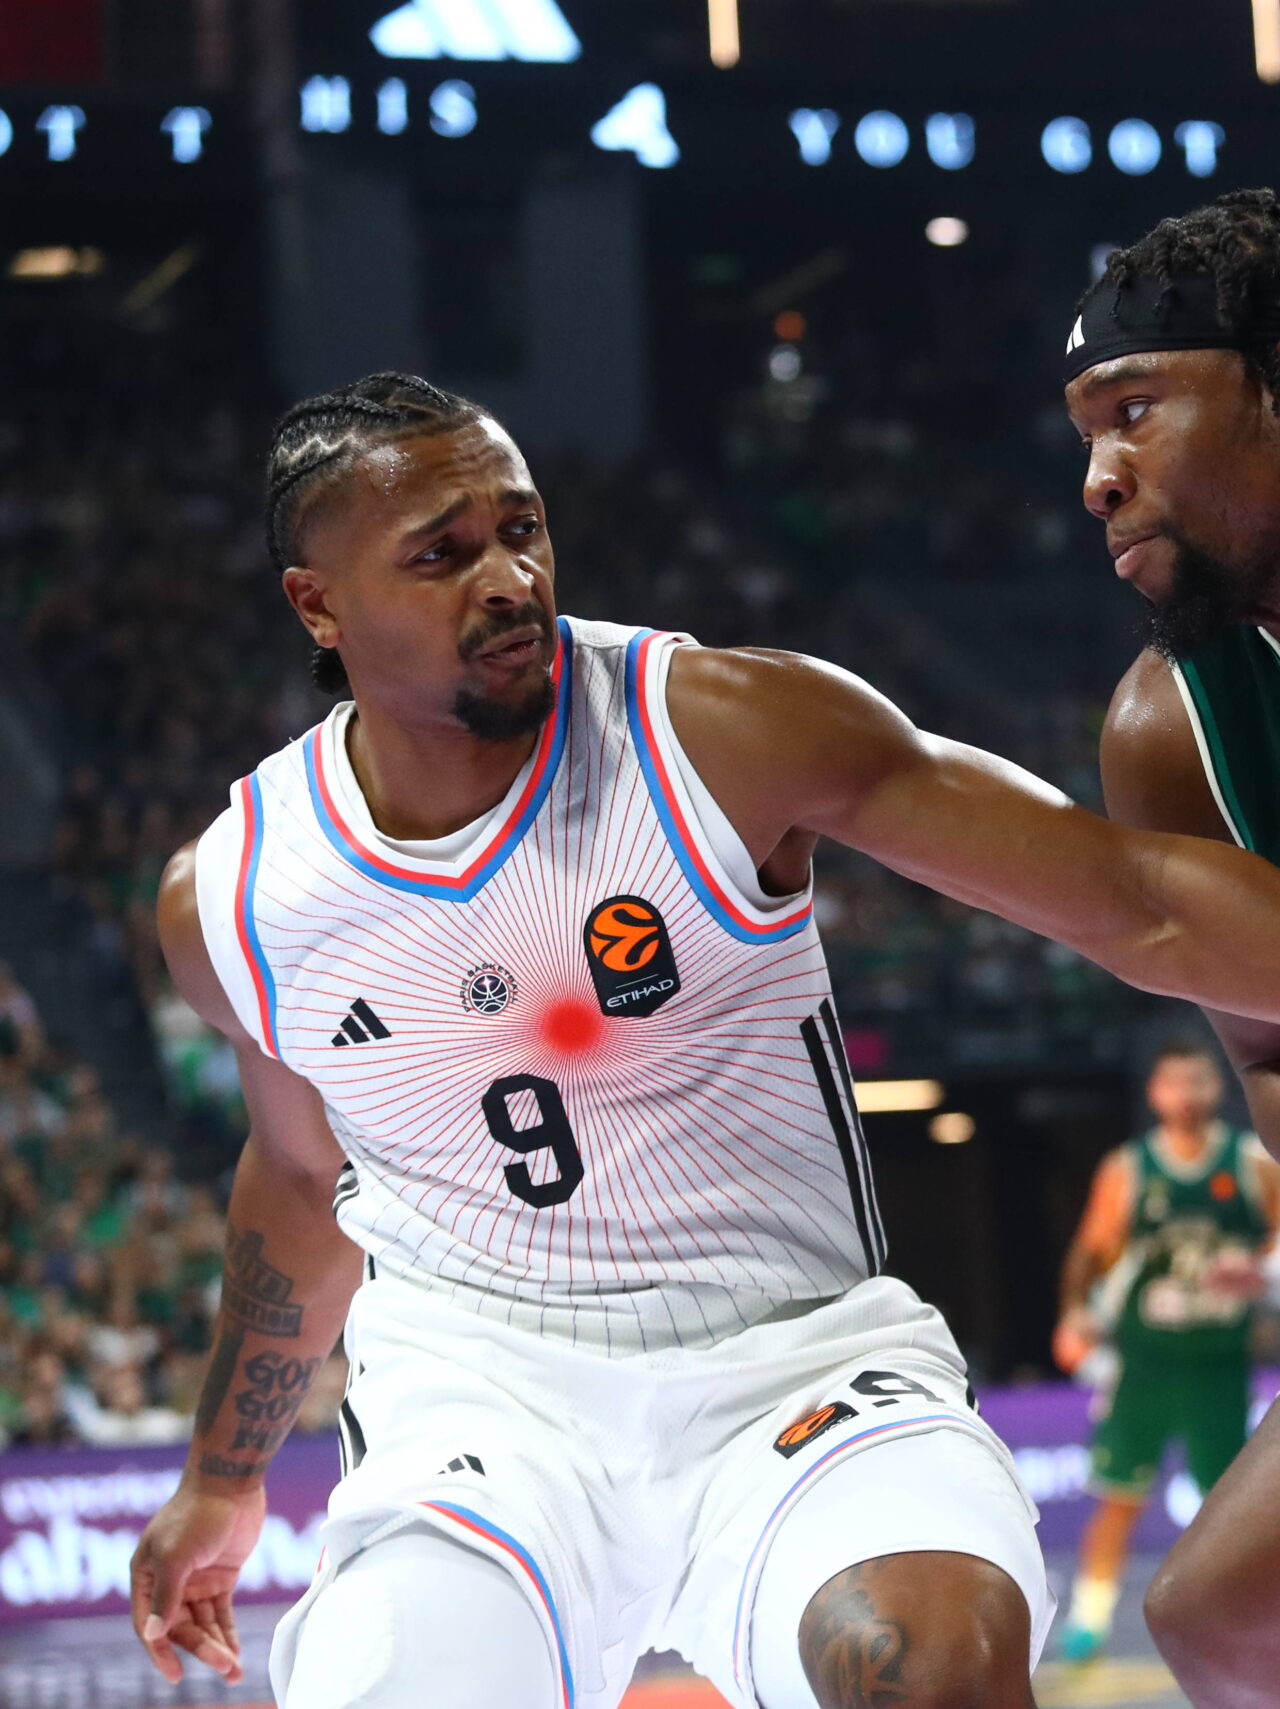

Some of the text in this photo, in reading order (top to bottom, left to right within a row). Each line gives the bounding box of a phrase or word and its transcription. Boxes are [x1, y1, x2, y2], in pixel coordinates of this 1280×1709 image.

[788, 107, 975, 170] YOU
[1041, 115, 1225, 177] GOT
[606, 978, 675, 1008] ETIHAD
[481, 1073, 584, 1209] 9
